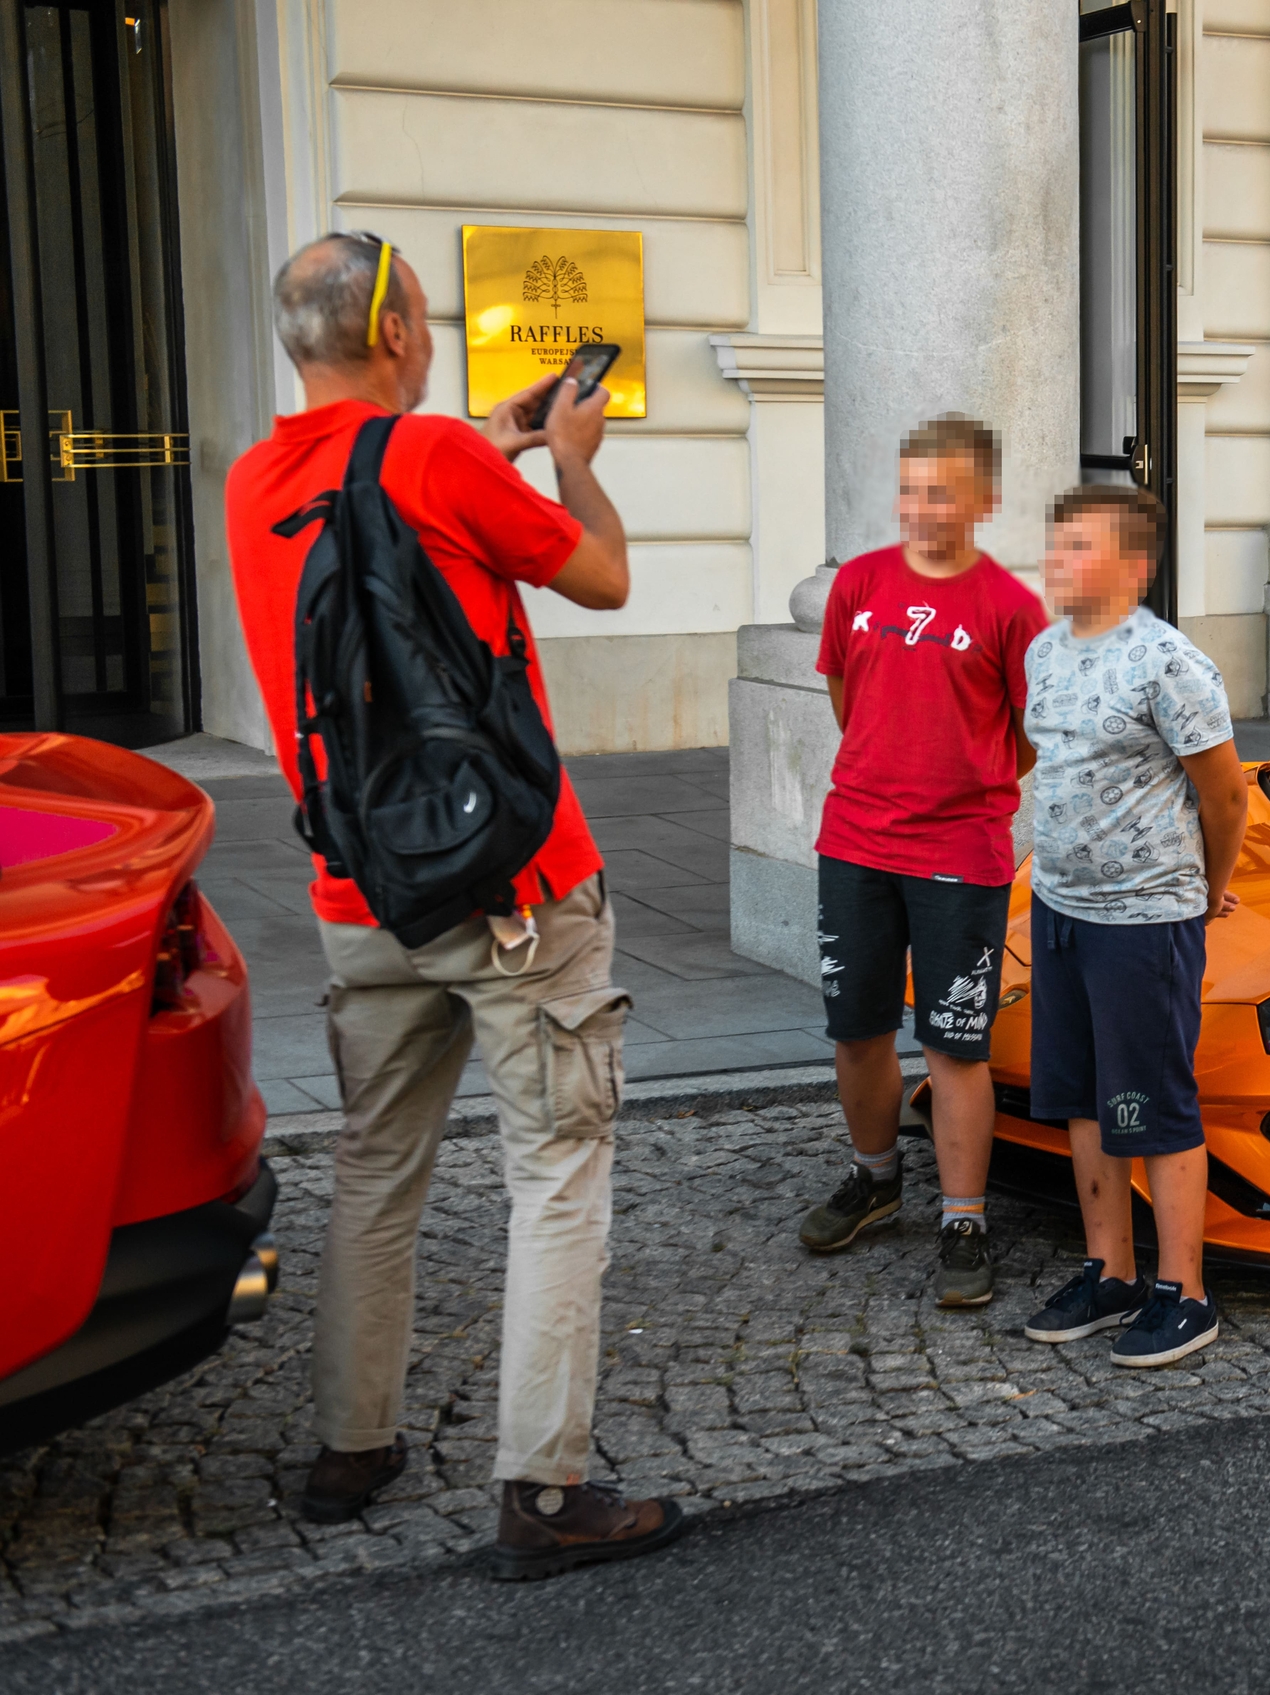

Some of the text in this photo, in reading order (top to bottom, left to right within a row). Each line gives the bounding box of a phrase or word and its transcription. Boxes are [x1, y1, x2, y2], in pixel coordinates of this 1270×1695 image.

[510, 325, 603, 343] RAFFLES
[531, 348, 577, 356] EUROPEJS
[905, 605, 936, 645] 7
[1107, 1091, 1150, 1107] SURF COAST
[1117, 1102, 1140, 1127] 02
